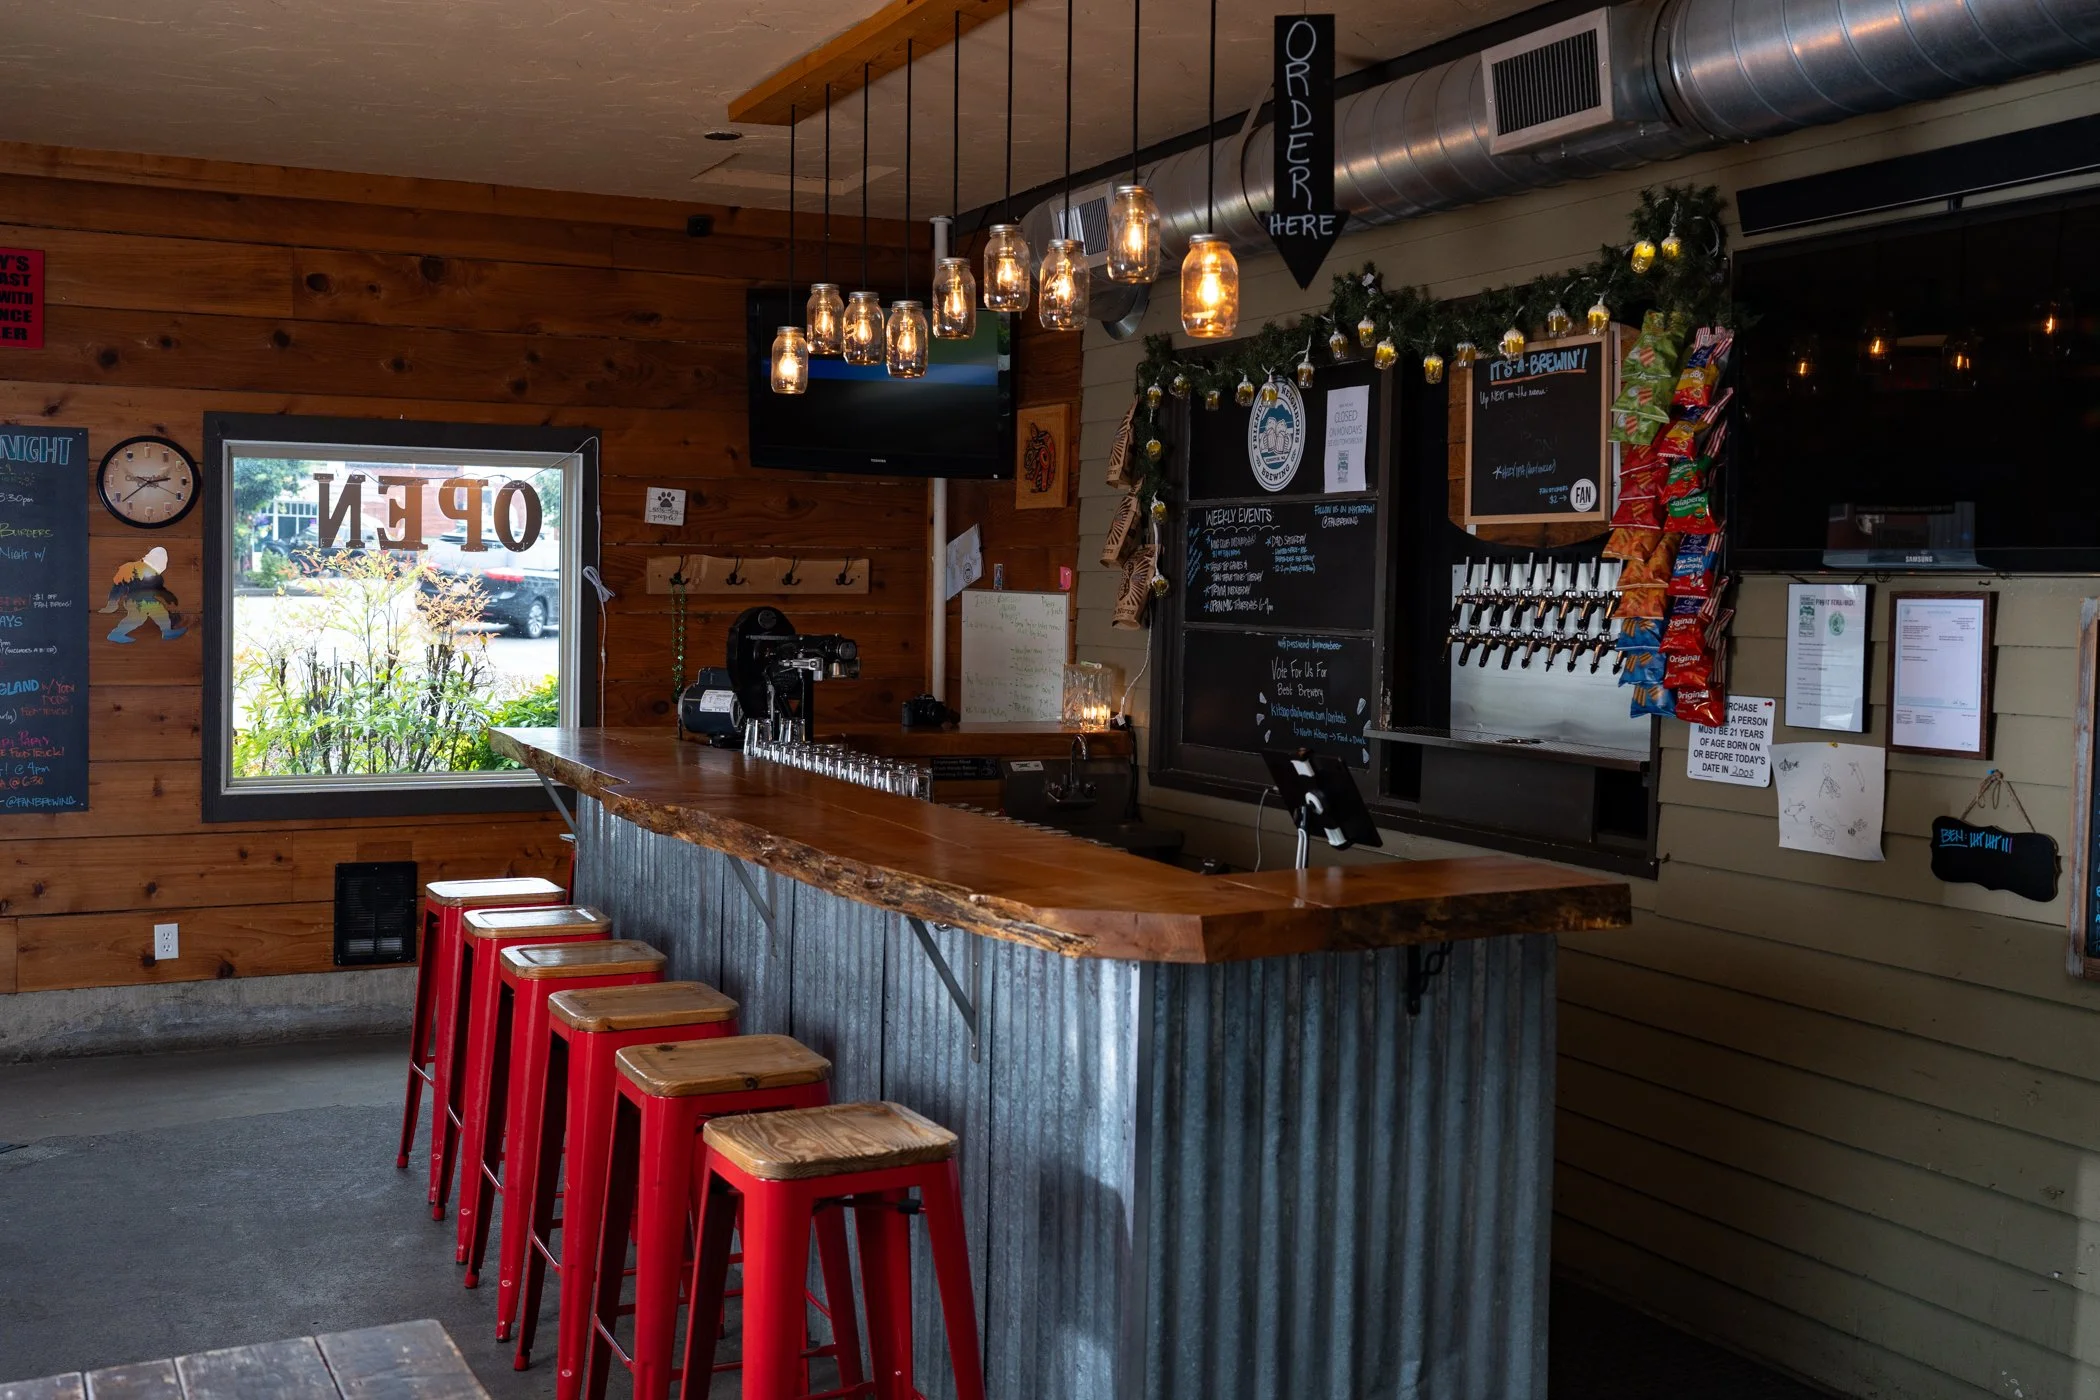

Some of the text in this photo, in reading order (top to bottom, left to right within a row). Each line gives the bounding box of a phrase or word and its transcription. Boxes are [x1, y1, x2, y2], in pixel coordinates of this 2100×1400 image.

[1285, 20, 1317, 211] ORDER
[1269, 213, 1336, 240] HERE
[1280, 384, 1301, 444] NEIGHBORS
[1334, 410, 1358, 424] CLOSED
[1260, 463, 1291, 481] BREWING
[1576, 486, 1592, 504] FAN
[1205, 508, 1236, 528] WEEKLY
[1905, 555, 1933, 563] SAMSUNG
[1669, 654, 1701, 664] Original
[1271, 656, 1288, 680] Vote
[1290, 658, 1303, 679] For
[1277, 682, 1293, 696] Best
[1731, 715, 1736, 723] A
[1737, 716, 1768, 726] PERSON
[1698, 725, 1764, 739] MUST BE 21 YEARS
[1700, 737, 1760, 751] OF AGE BORN ON
[1694, 749, 1765, 765] OR BEFORE TODAY'S
[1702, 763, 1720, 773] DATE
[1722, 765, 1729, 773] IN
